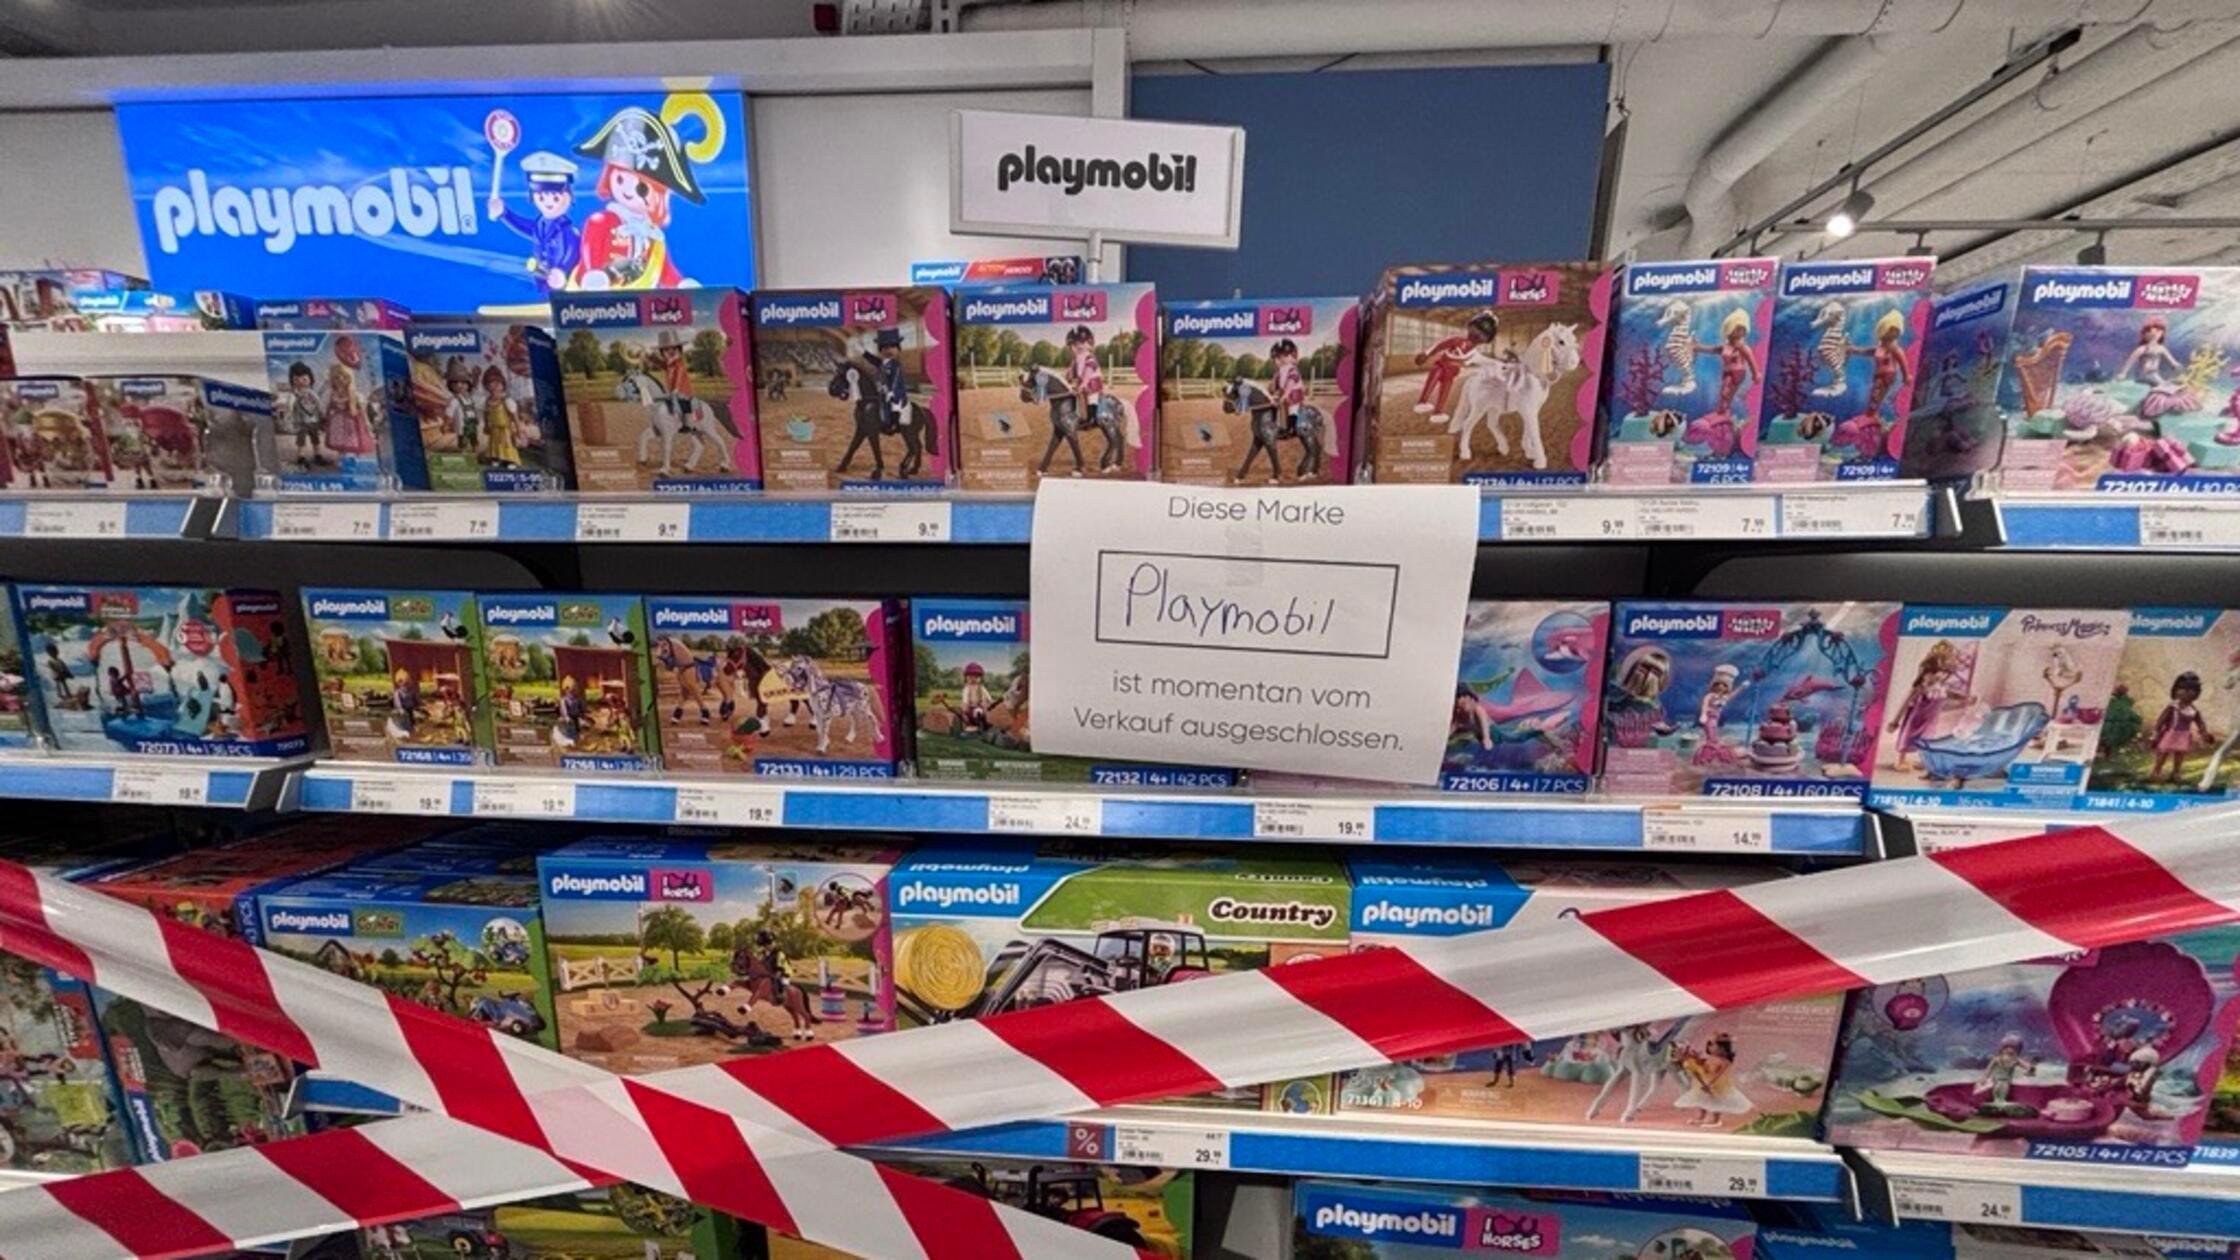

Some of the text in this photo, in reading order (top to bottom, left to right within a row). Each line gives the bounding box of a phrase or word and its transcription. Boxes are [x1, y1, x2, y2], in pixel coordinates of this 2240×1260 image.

[998, 145, 1197, 195] playmobil
[153, 167, 477, 254] playmobil
[1634, 269, 1716, 289] playmobil
[1790, 269, 1872, 291] playmobil
[1401, 280, 1494, 302] playmobil
[2034, 281, 2130, 302] playmobil
[560, 304, 637, 324] playmobil
[760, 302, 839, 324] playmobil
[966, 299, 1048, 321] playmobil
[1174, 312, 1255, 334] playmobil
[411, 333, 476, 351] playmobil
[1168, 496, 1344, 526] Diese Marke
[313, 600, 386, 618] playmobil
[1125, 562, 1335, 638] Playmobil
[487, 602, 555, 621] playmobil
[655, 608, 729, 627] playmobil
[925, 615, 1016, 636] playmobil
[1629, 615, 1719, 634] playmobil
[1908, 616, 1991, 632] playmobil
[1112, 670, 1371, 709] ist momentan vom
[1074, 706, 1404, 752] Verkauf ausgeschlossen.
[860, 765, 887, 779] PCS
[1095, 771, 1227, 788] 72132 4+ 42 PCS
[1450, 777, 1585, 792] 72106 4+ 7 PCS
[1711, 783, 1863, 797] 72108 4+ 60 PCS
[552, 874, 644, 895] playmobil
[900, 881, 1020, 908] playmobil
[271, 912, 349, 930] playmobil
[1211, 901, 1334, 926] Country
[1362, 901, 1493, 927] playmobil
[2033, 1143, 2088, 1158] 72105
[2097, 1145, 2121, 1159] 4+
[2153, 1149, 2188, 1164] PCS
[1316, 1203, 1456, 1237] playmobil
[1482, 1230, 1541, 1250] HORSES
